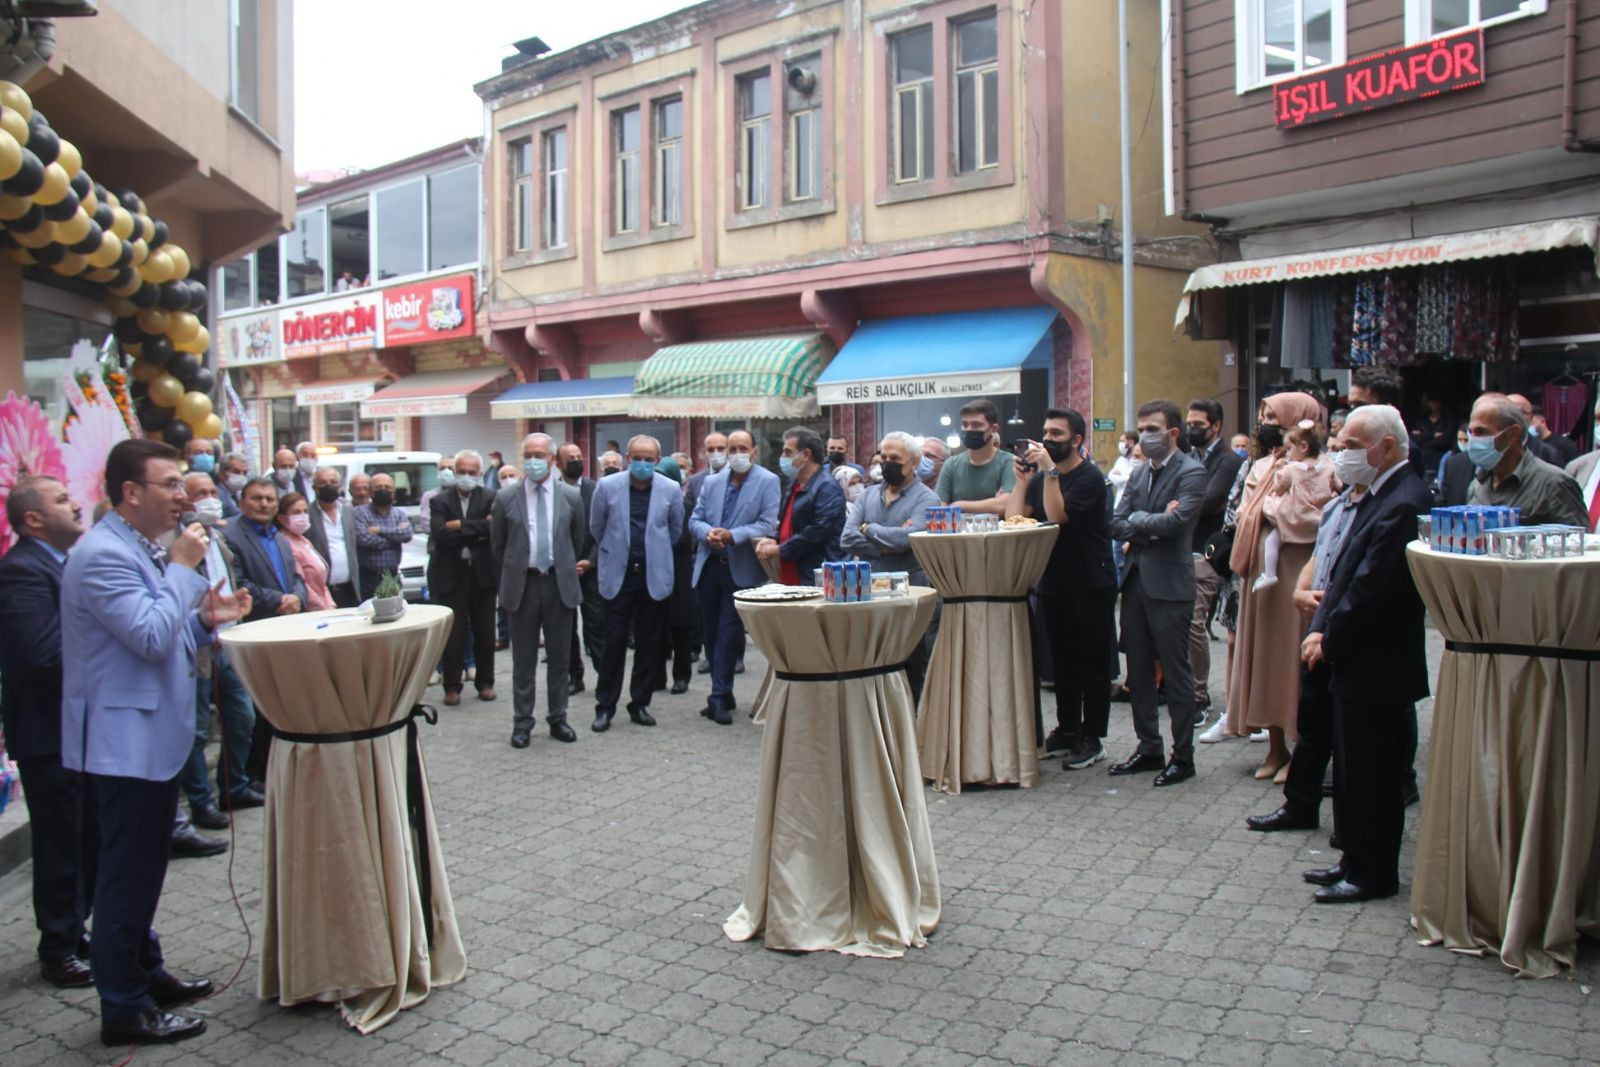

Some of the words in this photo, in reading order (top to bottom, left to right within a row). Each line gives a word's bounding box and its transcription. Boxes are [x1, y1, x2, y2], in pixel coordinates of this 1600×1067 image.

[1278, 80, 1337, 124] IŞIL
[1345, 40, 1479, 104] KUAFÖR
[1223, 264, 1277, 283] KURT
[1286, 244, 1443, 275] KONFEKSİYON
[283, 300, 377, 345] DÖNERCİM
[384, 293, 423, 320] kebir
[846, 383, 870, 399] REİS
[876, 381, 937, 398] BALIKÇILIK
